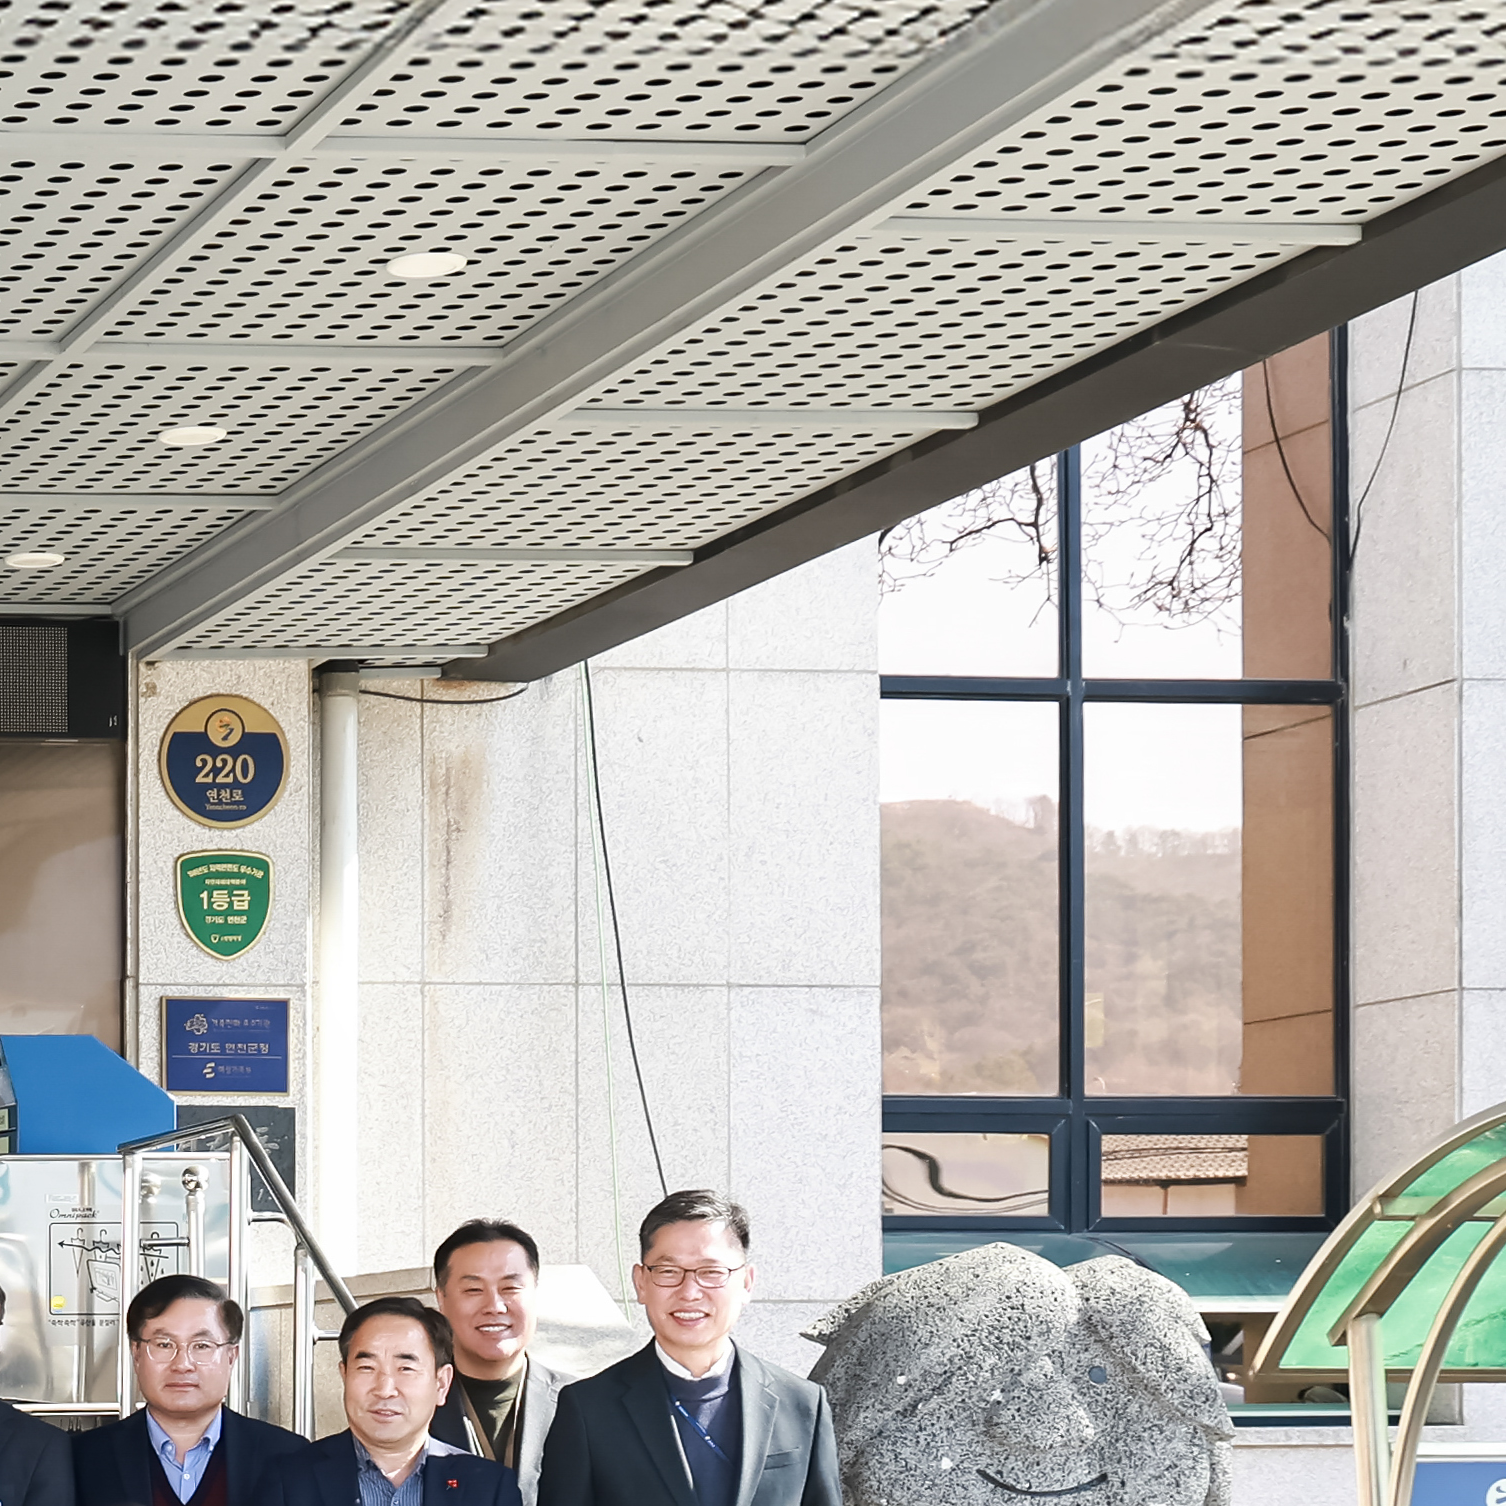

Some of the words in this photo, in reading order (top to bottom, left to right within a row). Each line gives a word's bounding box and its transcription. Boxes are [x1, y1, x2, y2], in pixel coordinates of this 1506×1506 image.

[195, 754, 255, 784] 220
[206, 788, 244, 803] 연천로
[199, 890, 251, 911] 1등급
